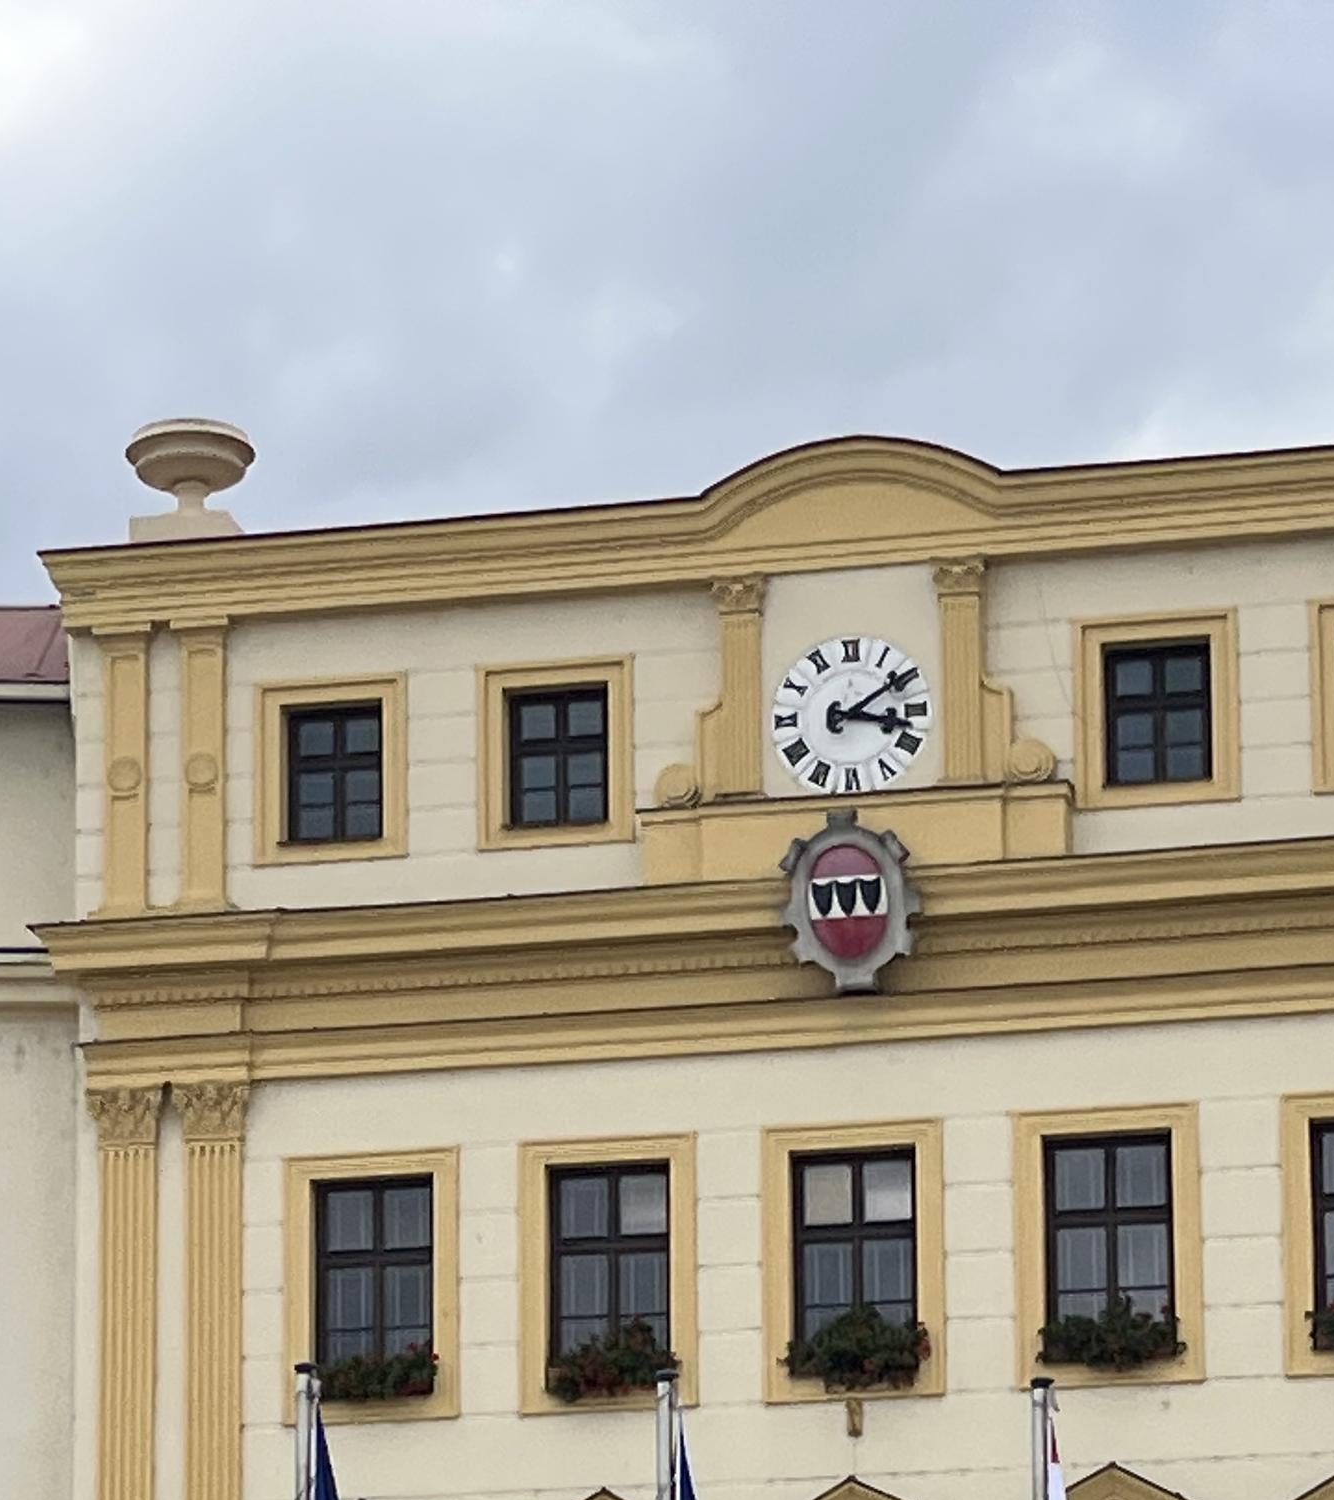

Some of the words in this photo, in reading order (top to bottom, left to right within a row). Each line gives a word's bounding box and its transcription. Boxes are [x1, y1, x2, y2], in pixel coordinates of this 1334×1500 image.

[806, 649, 831, 675] XI
[841, 638, 860, 663] XII
[875, 645, 891, 668] I
[783, 677, 808, 697] X
[877, 758, 897, 781] V
